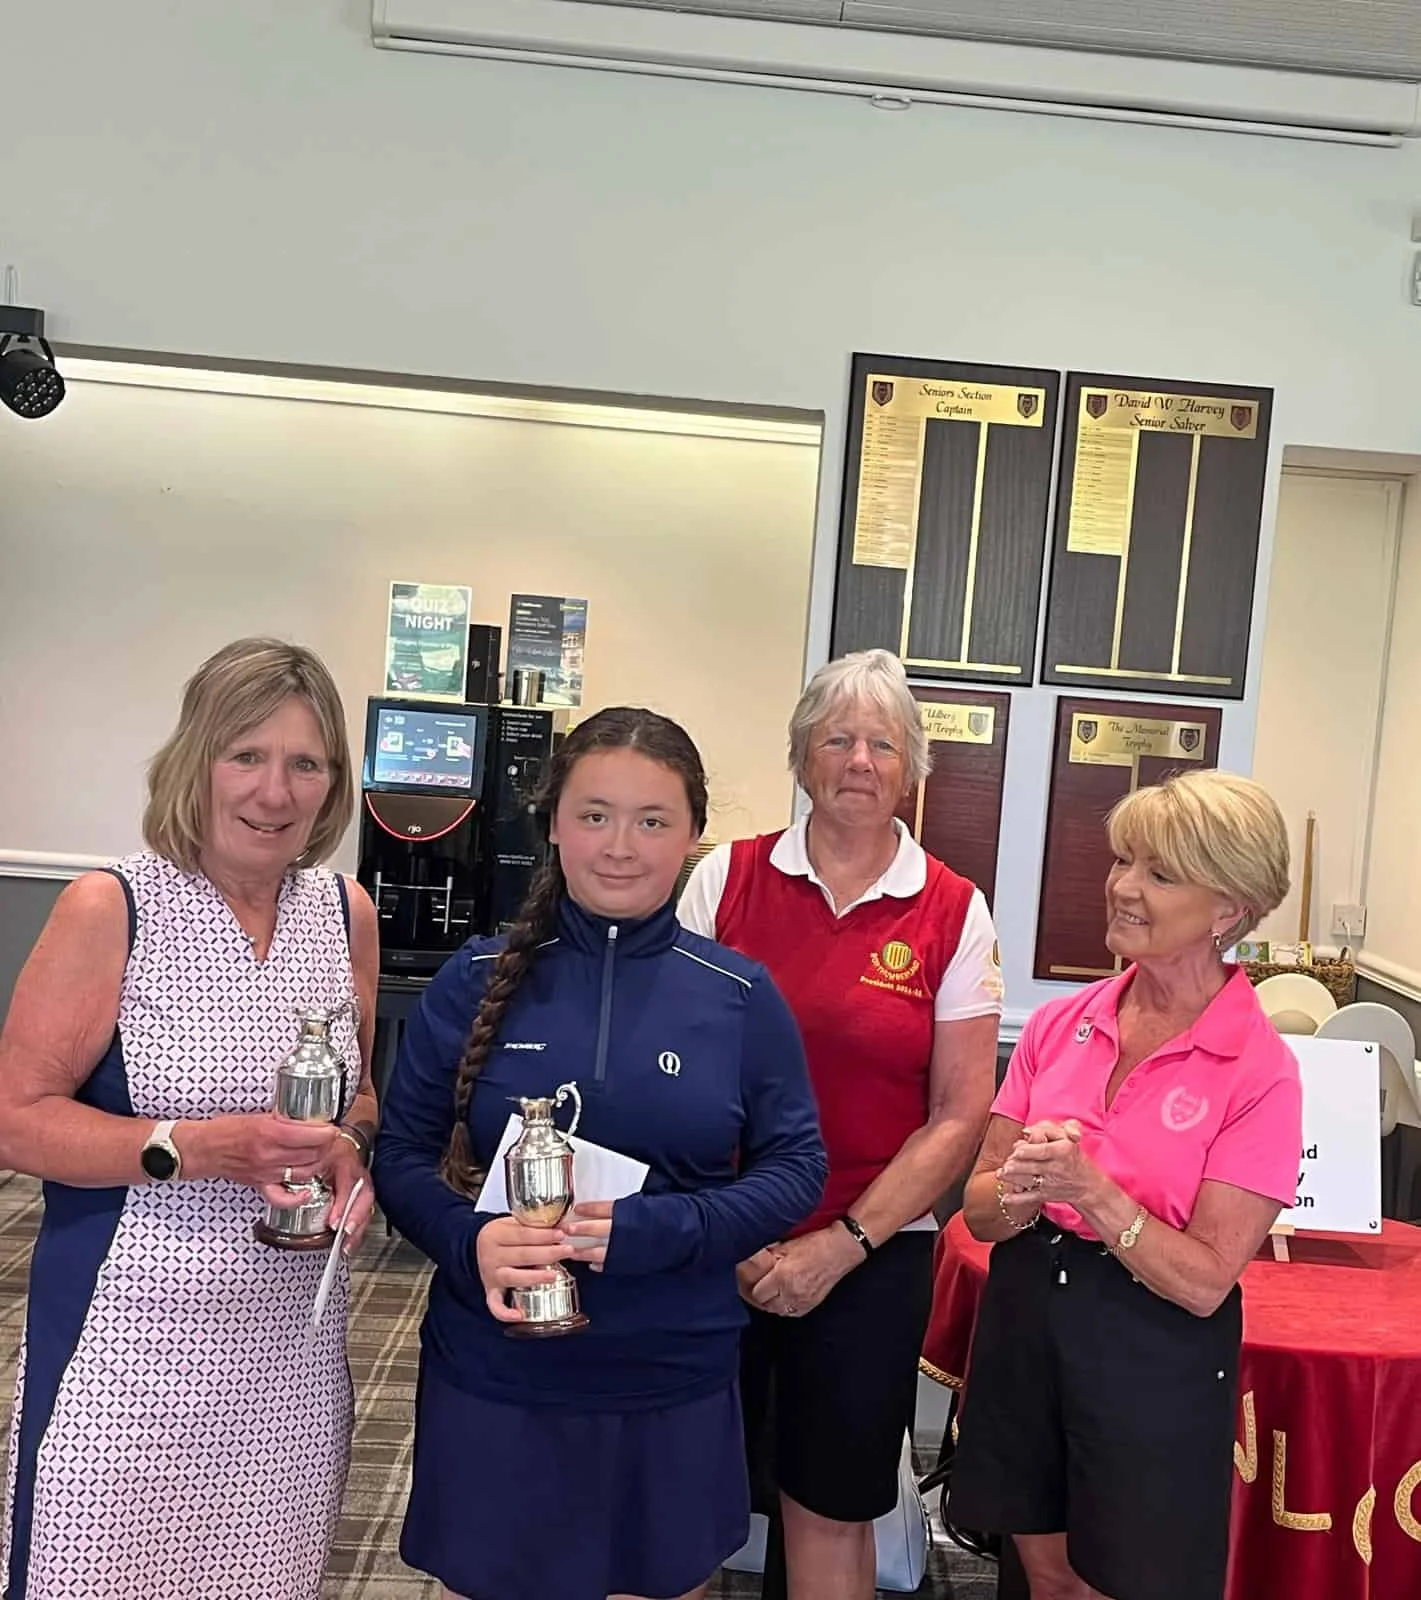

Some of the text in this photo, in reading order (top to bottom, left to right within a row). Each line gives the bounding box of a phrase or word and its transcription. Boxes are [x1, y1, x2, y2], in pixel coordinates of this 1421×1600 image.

[919, 384, 992, 401] Seniors Section
[936, 401, 973, 416] Captain
[1114, 393, 1151, 409] David
[1177, 399, 1225, 419] Harvey
[1130, 413, 1206, 431] Senior Salver
[405, 614, 454, 631] NIGHT
